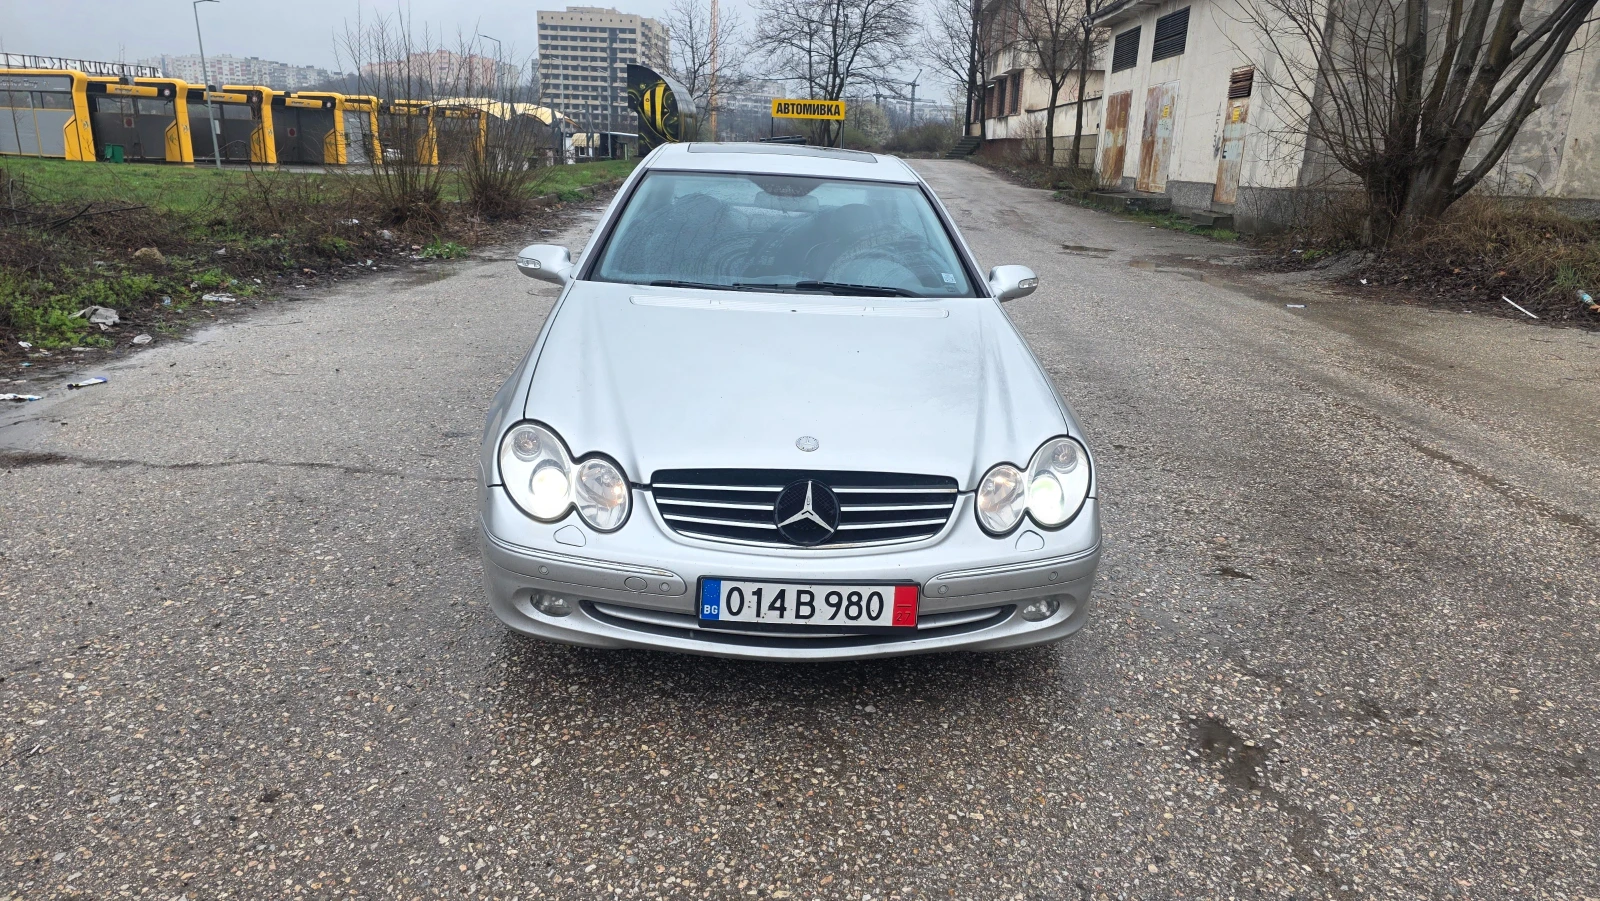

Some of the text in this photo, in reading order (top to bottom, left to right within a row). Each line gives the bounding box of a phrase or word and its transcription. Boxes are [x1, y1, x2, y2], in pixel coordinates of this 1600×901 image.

[776, 102, 841, 116] АВТОМИВКА
[703, 604, 719, 615] BG
[896, 610, 912, 622] 27
